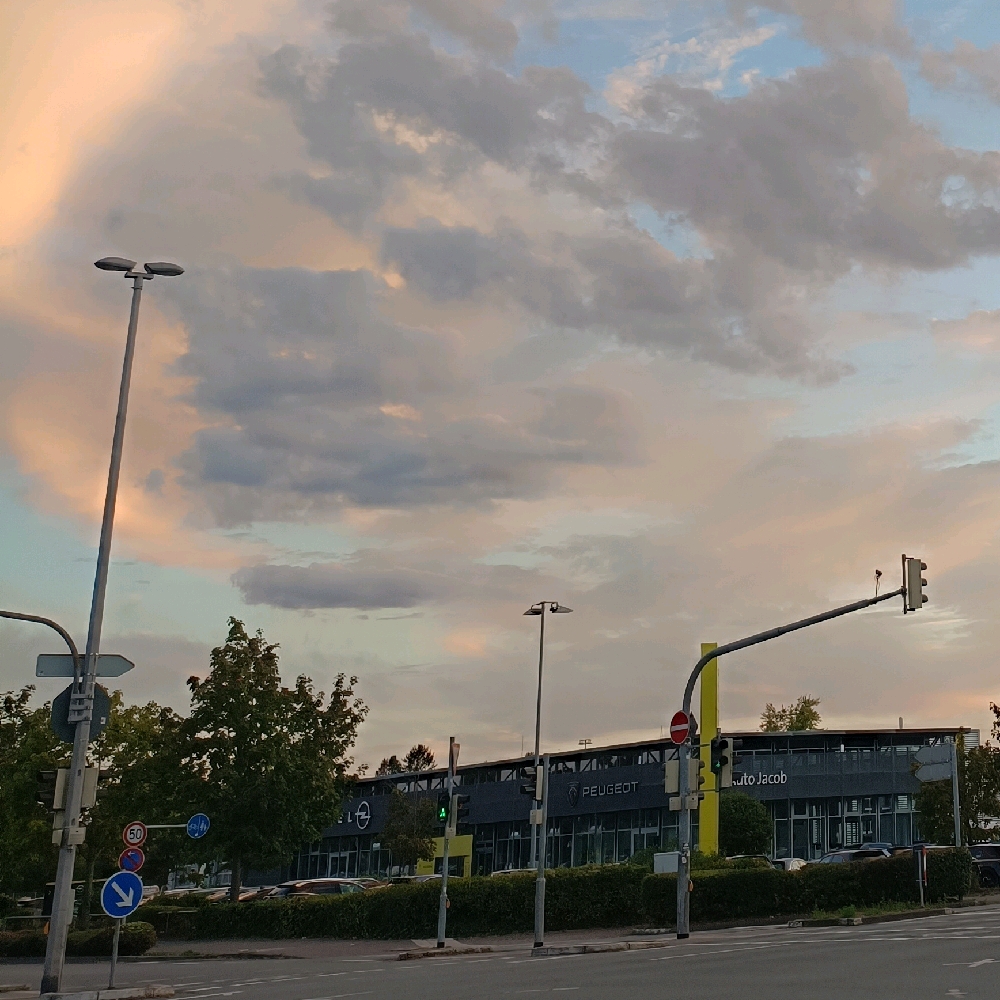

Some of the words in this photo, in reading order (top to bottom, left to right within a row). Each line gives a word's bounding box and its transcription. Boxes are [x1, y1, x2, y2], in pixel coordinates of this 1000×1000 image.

[756, 770, 788, 785] Jacob
[582, 781, 639, 798] PEUGEOT
[129, 828, 143, 840] 50
